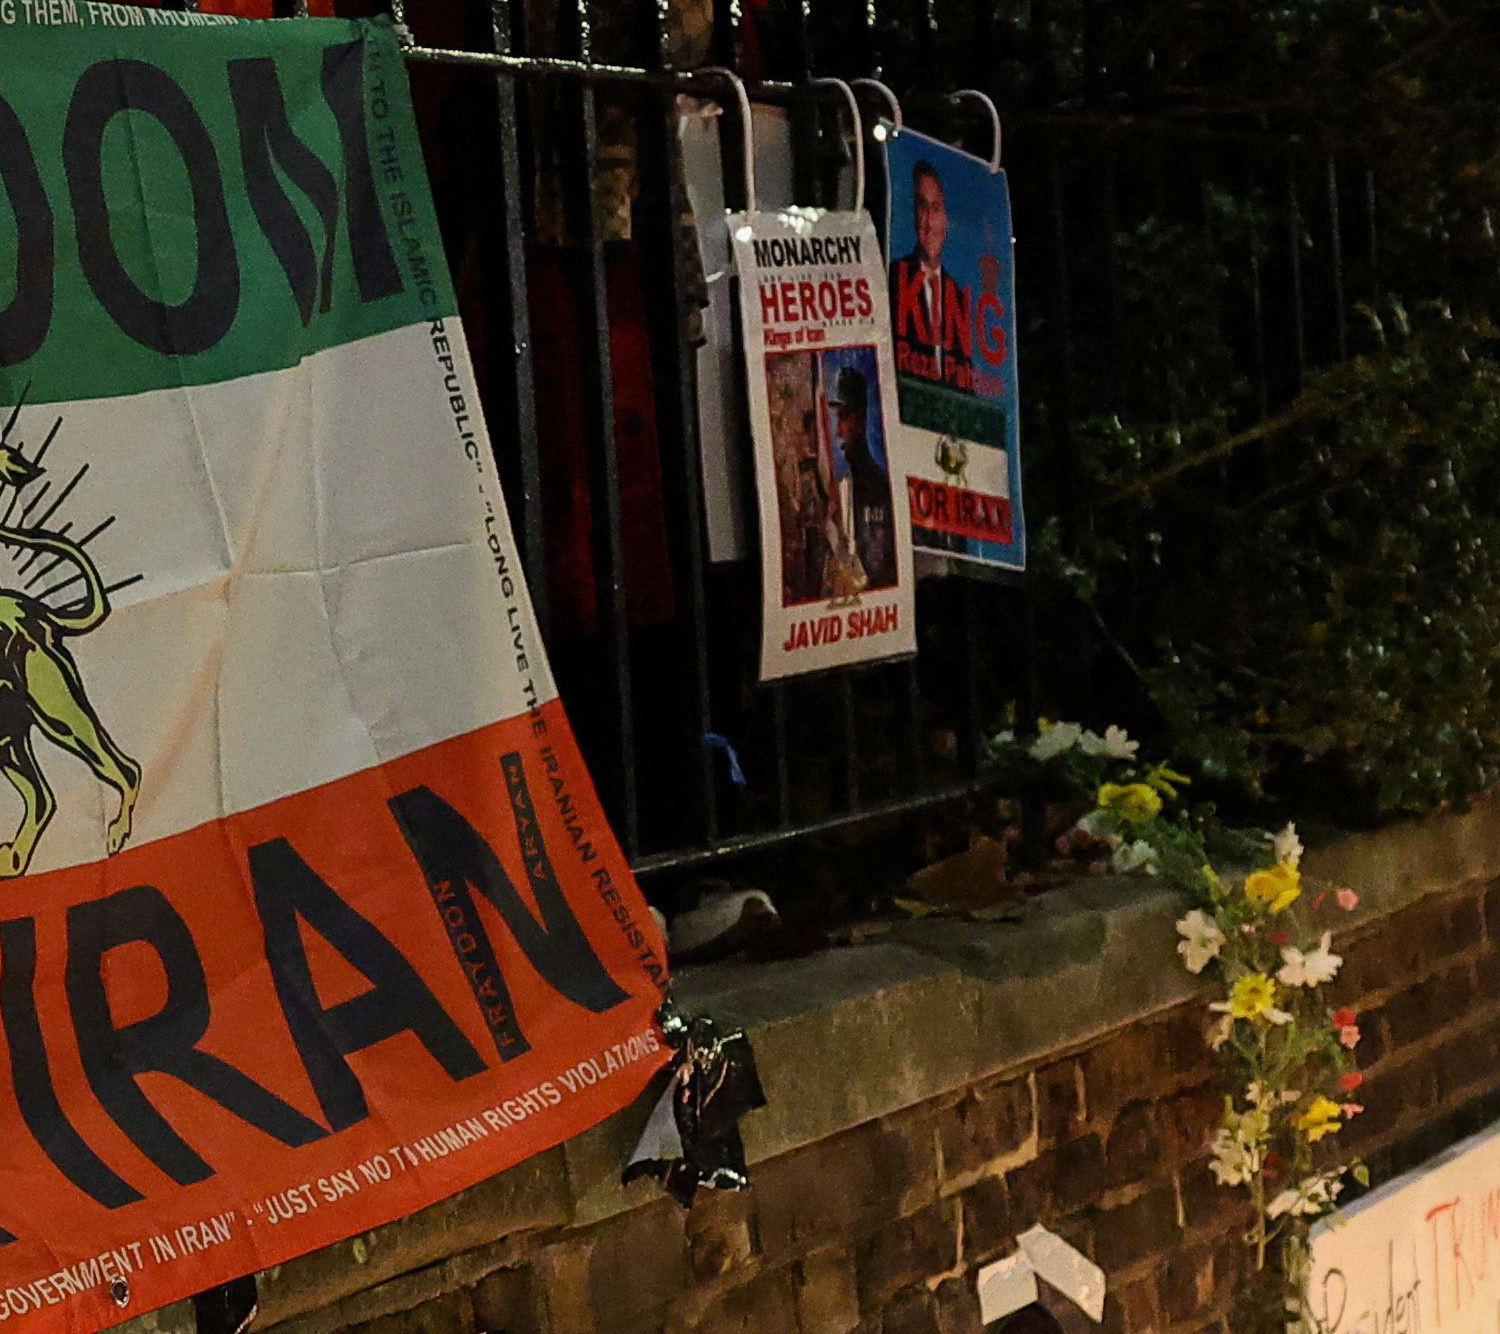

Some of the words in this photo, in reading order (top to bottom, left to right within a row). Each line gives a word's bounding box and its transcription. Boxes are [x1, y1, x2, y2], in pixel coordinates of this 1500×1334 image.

[22, 0, 85, 29] THEM,
[87, 2, 146, 27] FROM
[376, 136, 402, 186] THE
[384, 188, 440, 308] ISLAMIC
[753, 235, 862, 268] MONARCHY
[759, 277, 874, 324] HEROES
[897, 261, 1007, 366] KING
[910, 480, 949, 517] OR
[506, 606, 530, 674] LIVE
[784, 616, 843, 652] JAVID
[847, 603, 899, 640] SHAH
[522, 677, 548, 737] THE
[539, 746, 597, 864] IRANIAN
[152, 1230, 181, 1267] IN
[317, 1168, 363, 1214] SAY
[364, 1153, 395, 1188] NO
[418, 1117, 488, 1163] HUMAN
[483, 1080, 563, 1128] RIGHTS
[559, 1028, 661, 1100] VIOLATIONS
